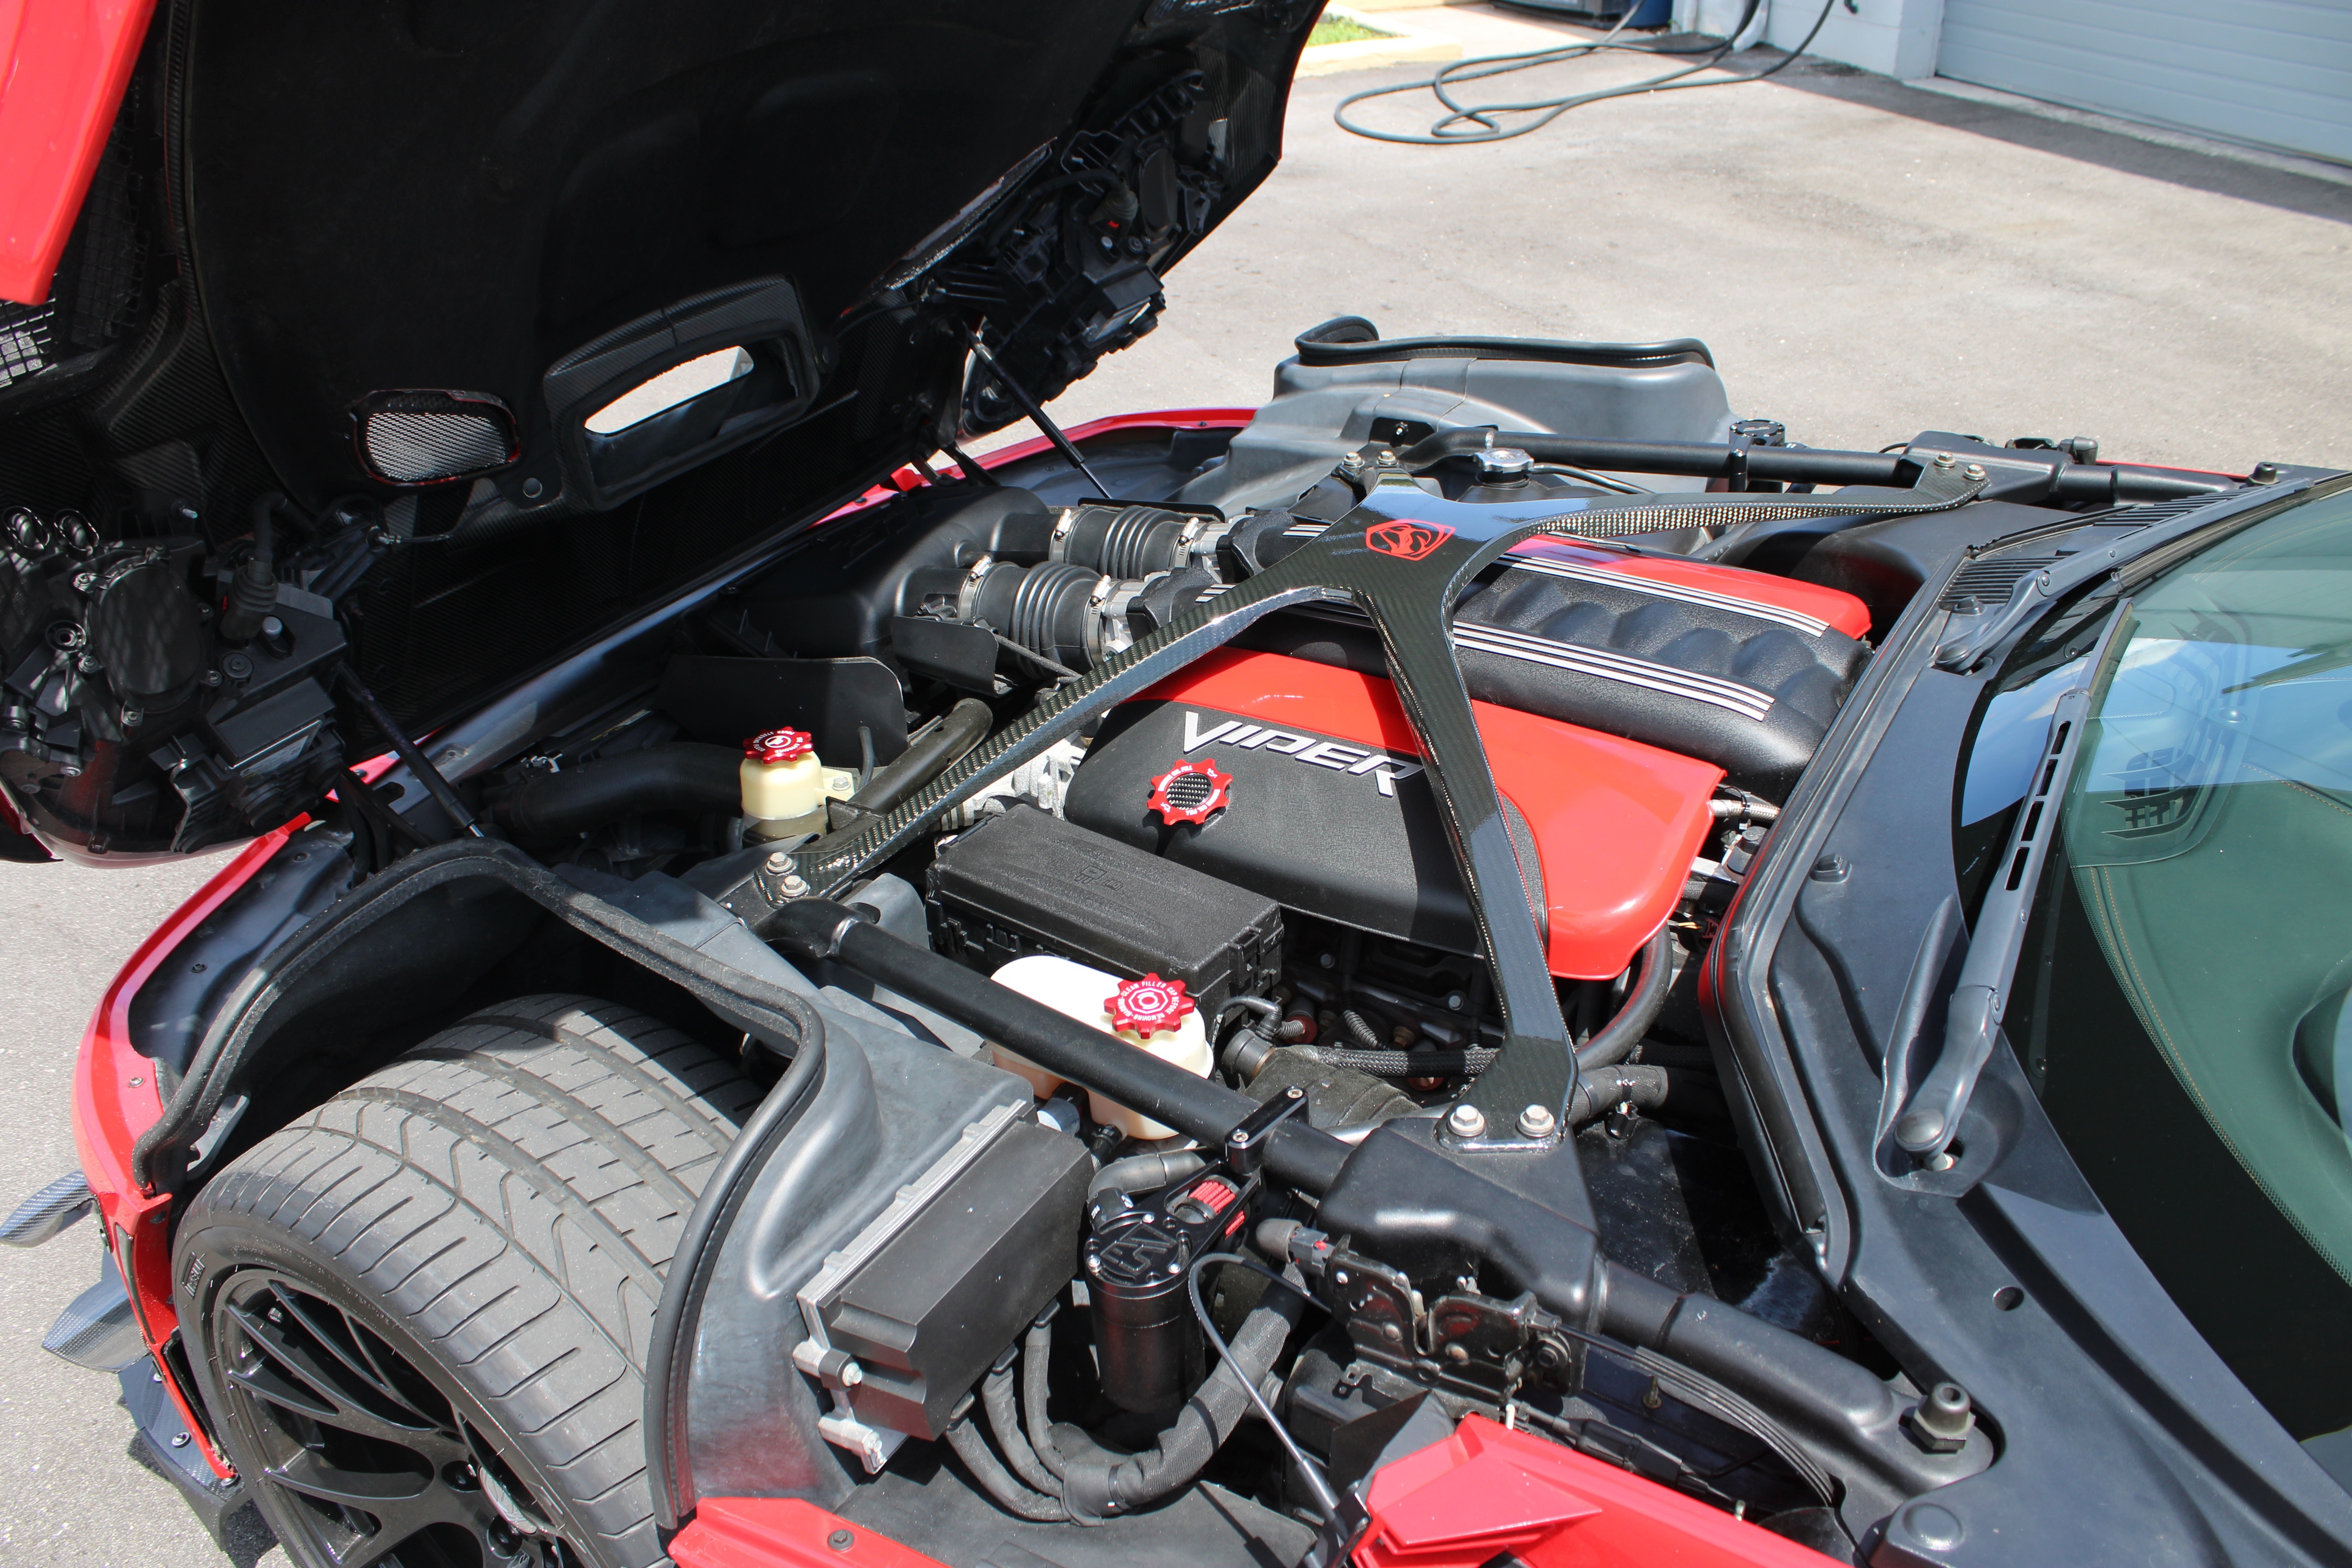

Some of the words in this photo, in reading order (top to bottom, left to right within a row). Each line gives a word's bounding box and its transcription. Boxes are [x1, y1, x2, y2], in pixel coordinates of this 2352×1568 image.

[1183, 711, 1424, 797] VIPER
[1121, 983, 1139, 997] CLEAN
[1166, 987, 1178, 996] CAP
[1165, 996, 1179, 1015] BEFORE
